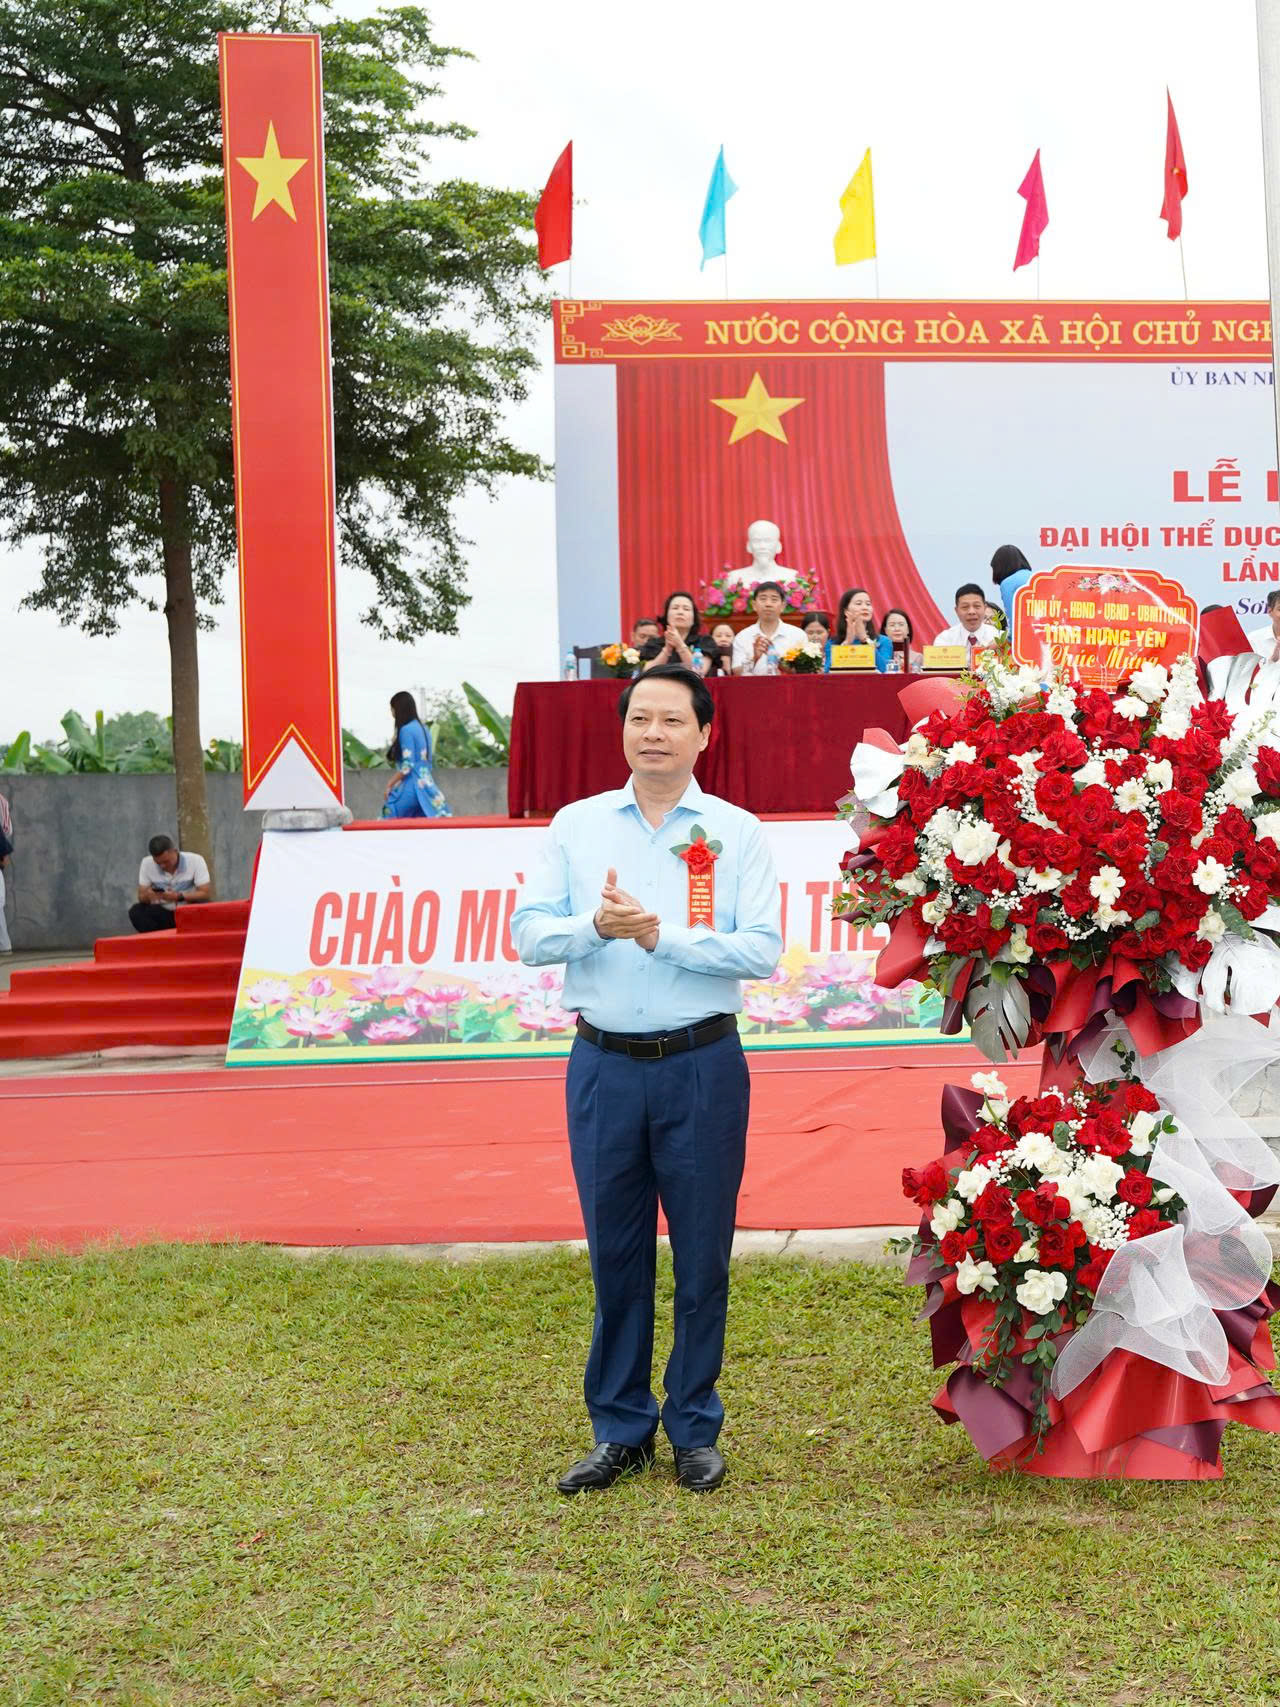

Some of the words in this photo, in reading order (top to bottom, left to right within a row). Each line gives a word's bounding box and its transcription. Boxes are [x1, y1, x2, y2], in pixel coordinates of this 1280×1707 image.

[704, 311, 800, 345] NƯỚC
[808, 311, 905, 350] CỘNG
[914, 311, 990, 345] HÒA
[999, 314, 1051, 345] XÃ
[1059, 312, 1122, 351] HỘI
[1133, 309, 1201, 346] CHỦ
[1171, 366, 1198, 386] ỦY
[1205, 371, 1247, 386] BAN
[1173, 458, 1242, 503] LỄ
[1039, 527, 1089, 552] ĐẠI
[1100, 522, 1149, 552] HỘI
[1160, 518, 1216, 547] THỂ
[1222, 553, 1280, 583] LẦN
[1085, 625, 1130, 647] HƯNG
[1135, 627, 1167, 649] YÊN
[309, 874, 441, 967] CHÀO
